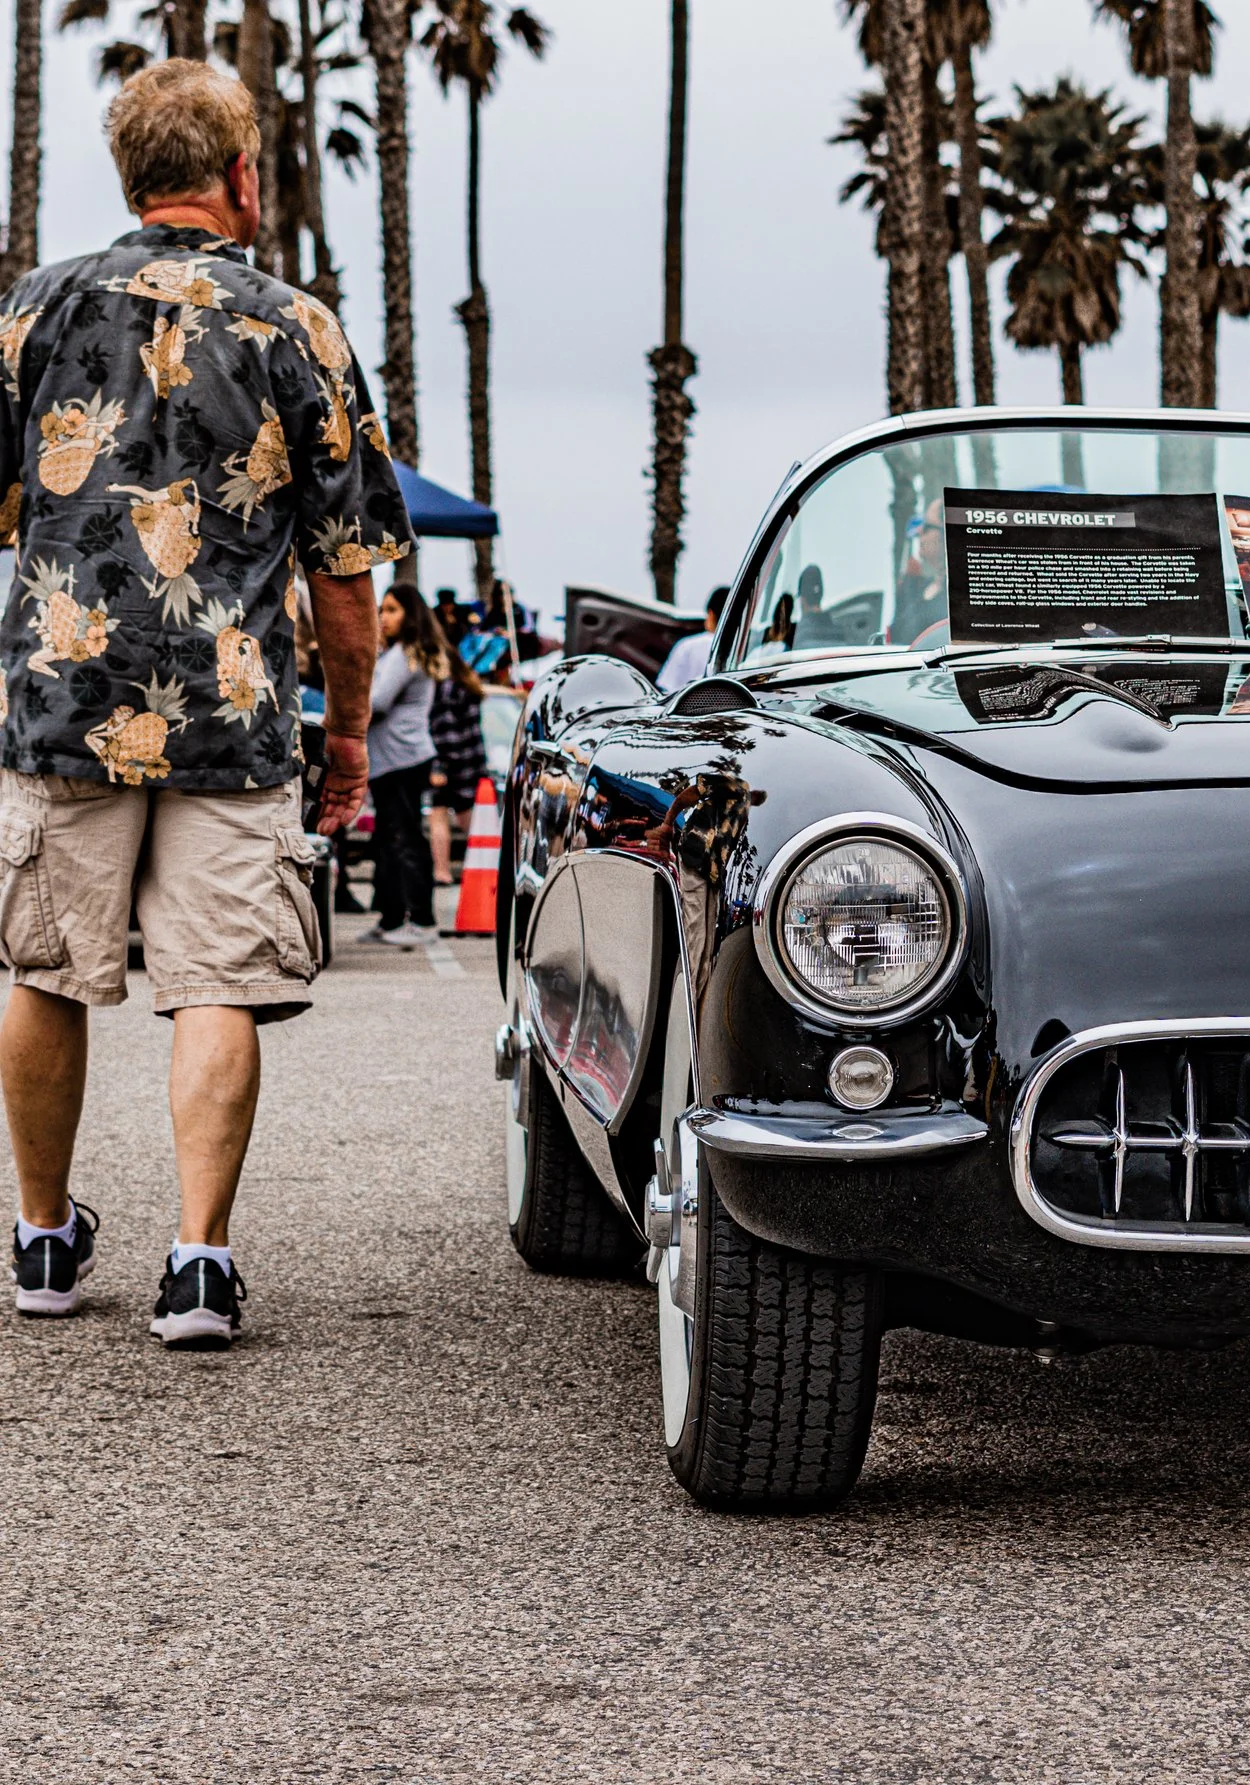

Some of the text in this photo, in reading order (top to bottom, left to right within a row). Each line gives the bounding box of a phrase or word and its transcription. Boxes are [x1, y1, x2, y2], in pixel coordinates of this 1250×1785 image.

[966, 510, 1116, 526] 1956 CHEVROLET
[966, 527, 1003, 535] Corvette
